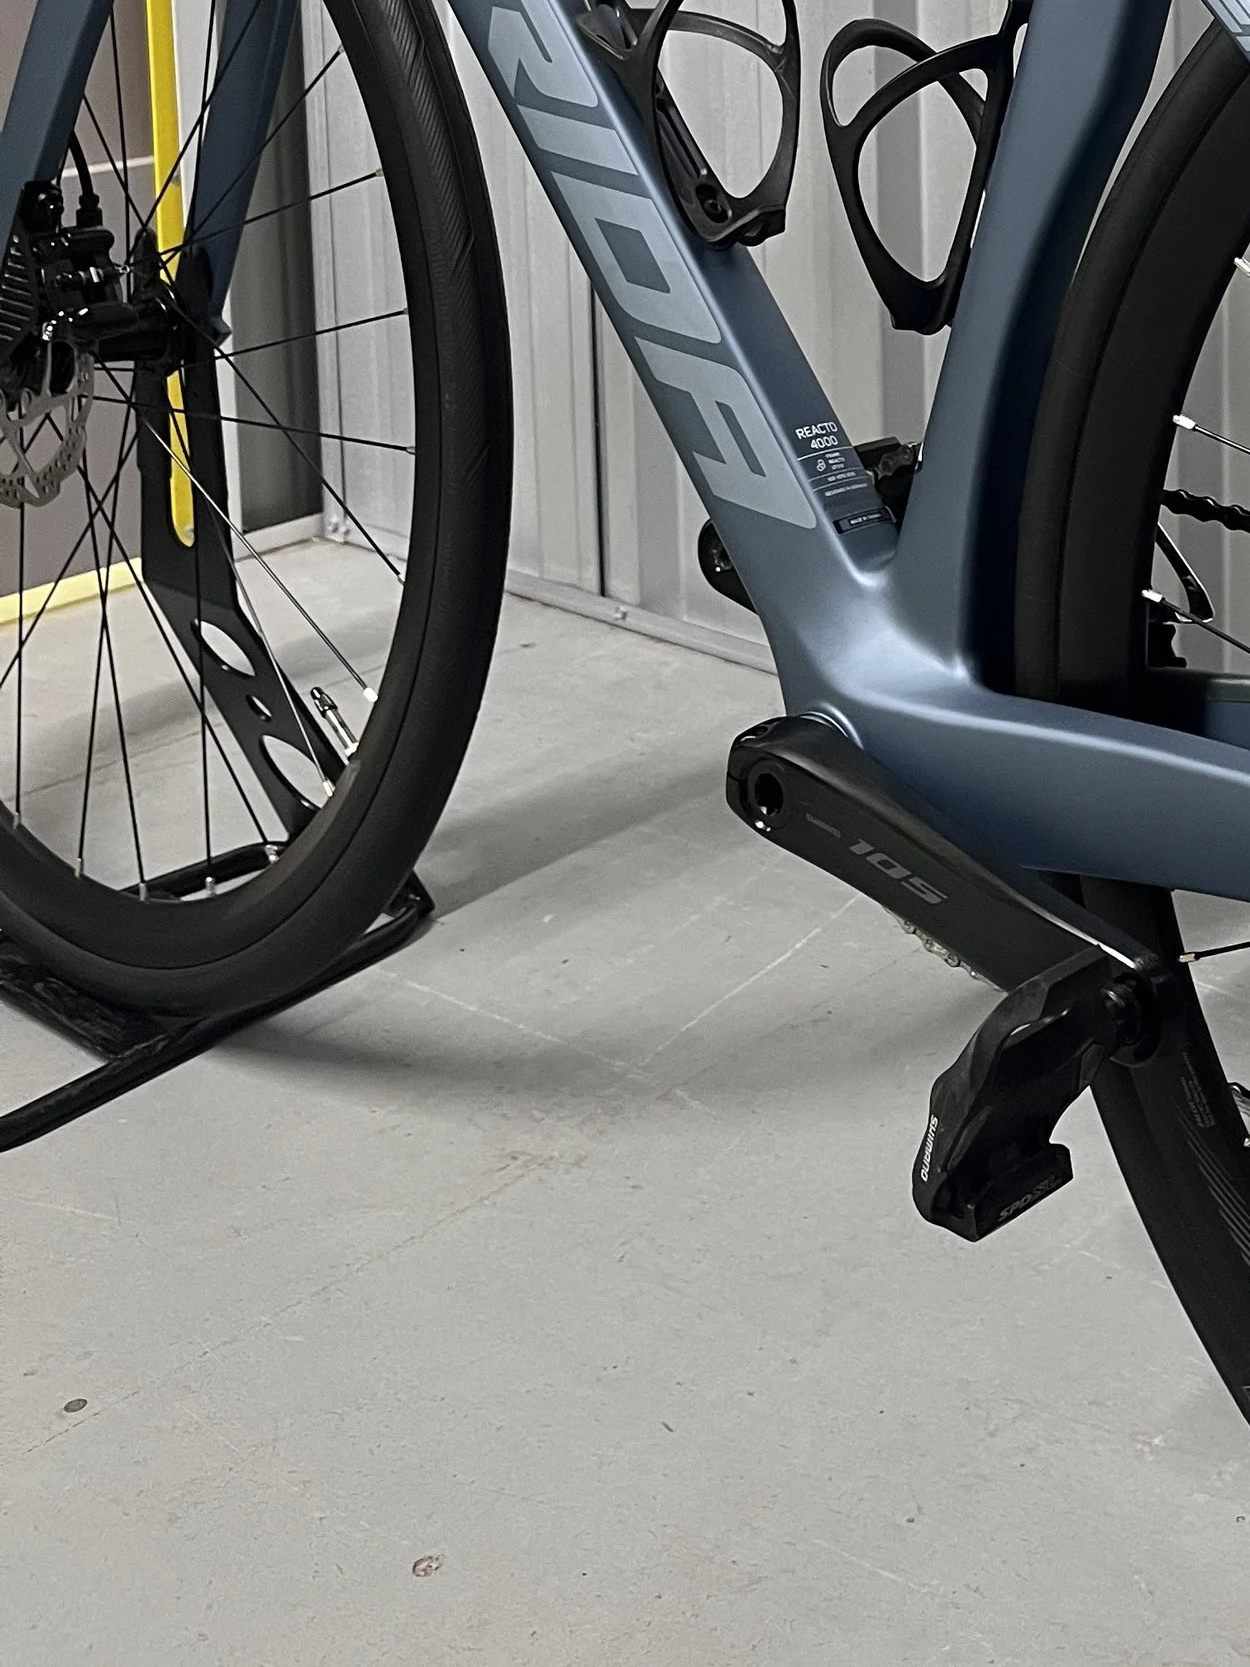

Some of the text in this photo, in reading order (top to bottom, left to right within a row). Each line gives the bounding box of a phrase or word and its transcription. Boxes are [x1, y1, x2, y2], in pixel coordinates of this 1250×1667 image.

[795, 421, 839, 440] REACTO
[810, 435, 839, 450] 4000
[848, 837, 948, 905] 105
[919, 1113, 939, 1183] SHIMANO
